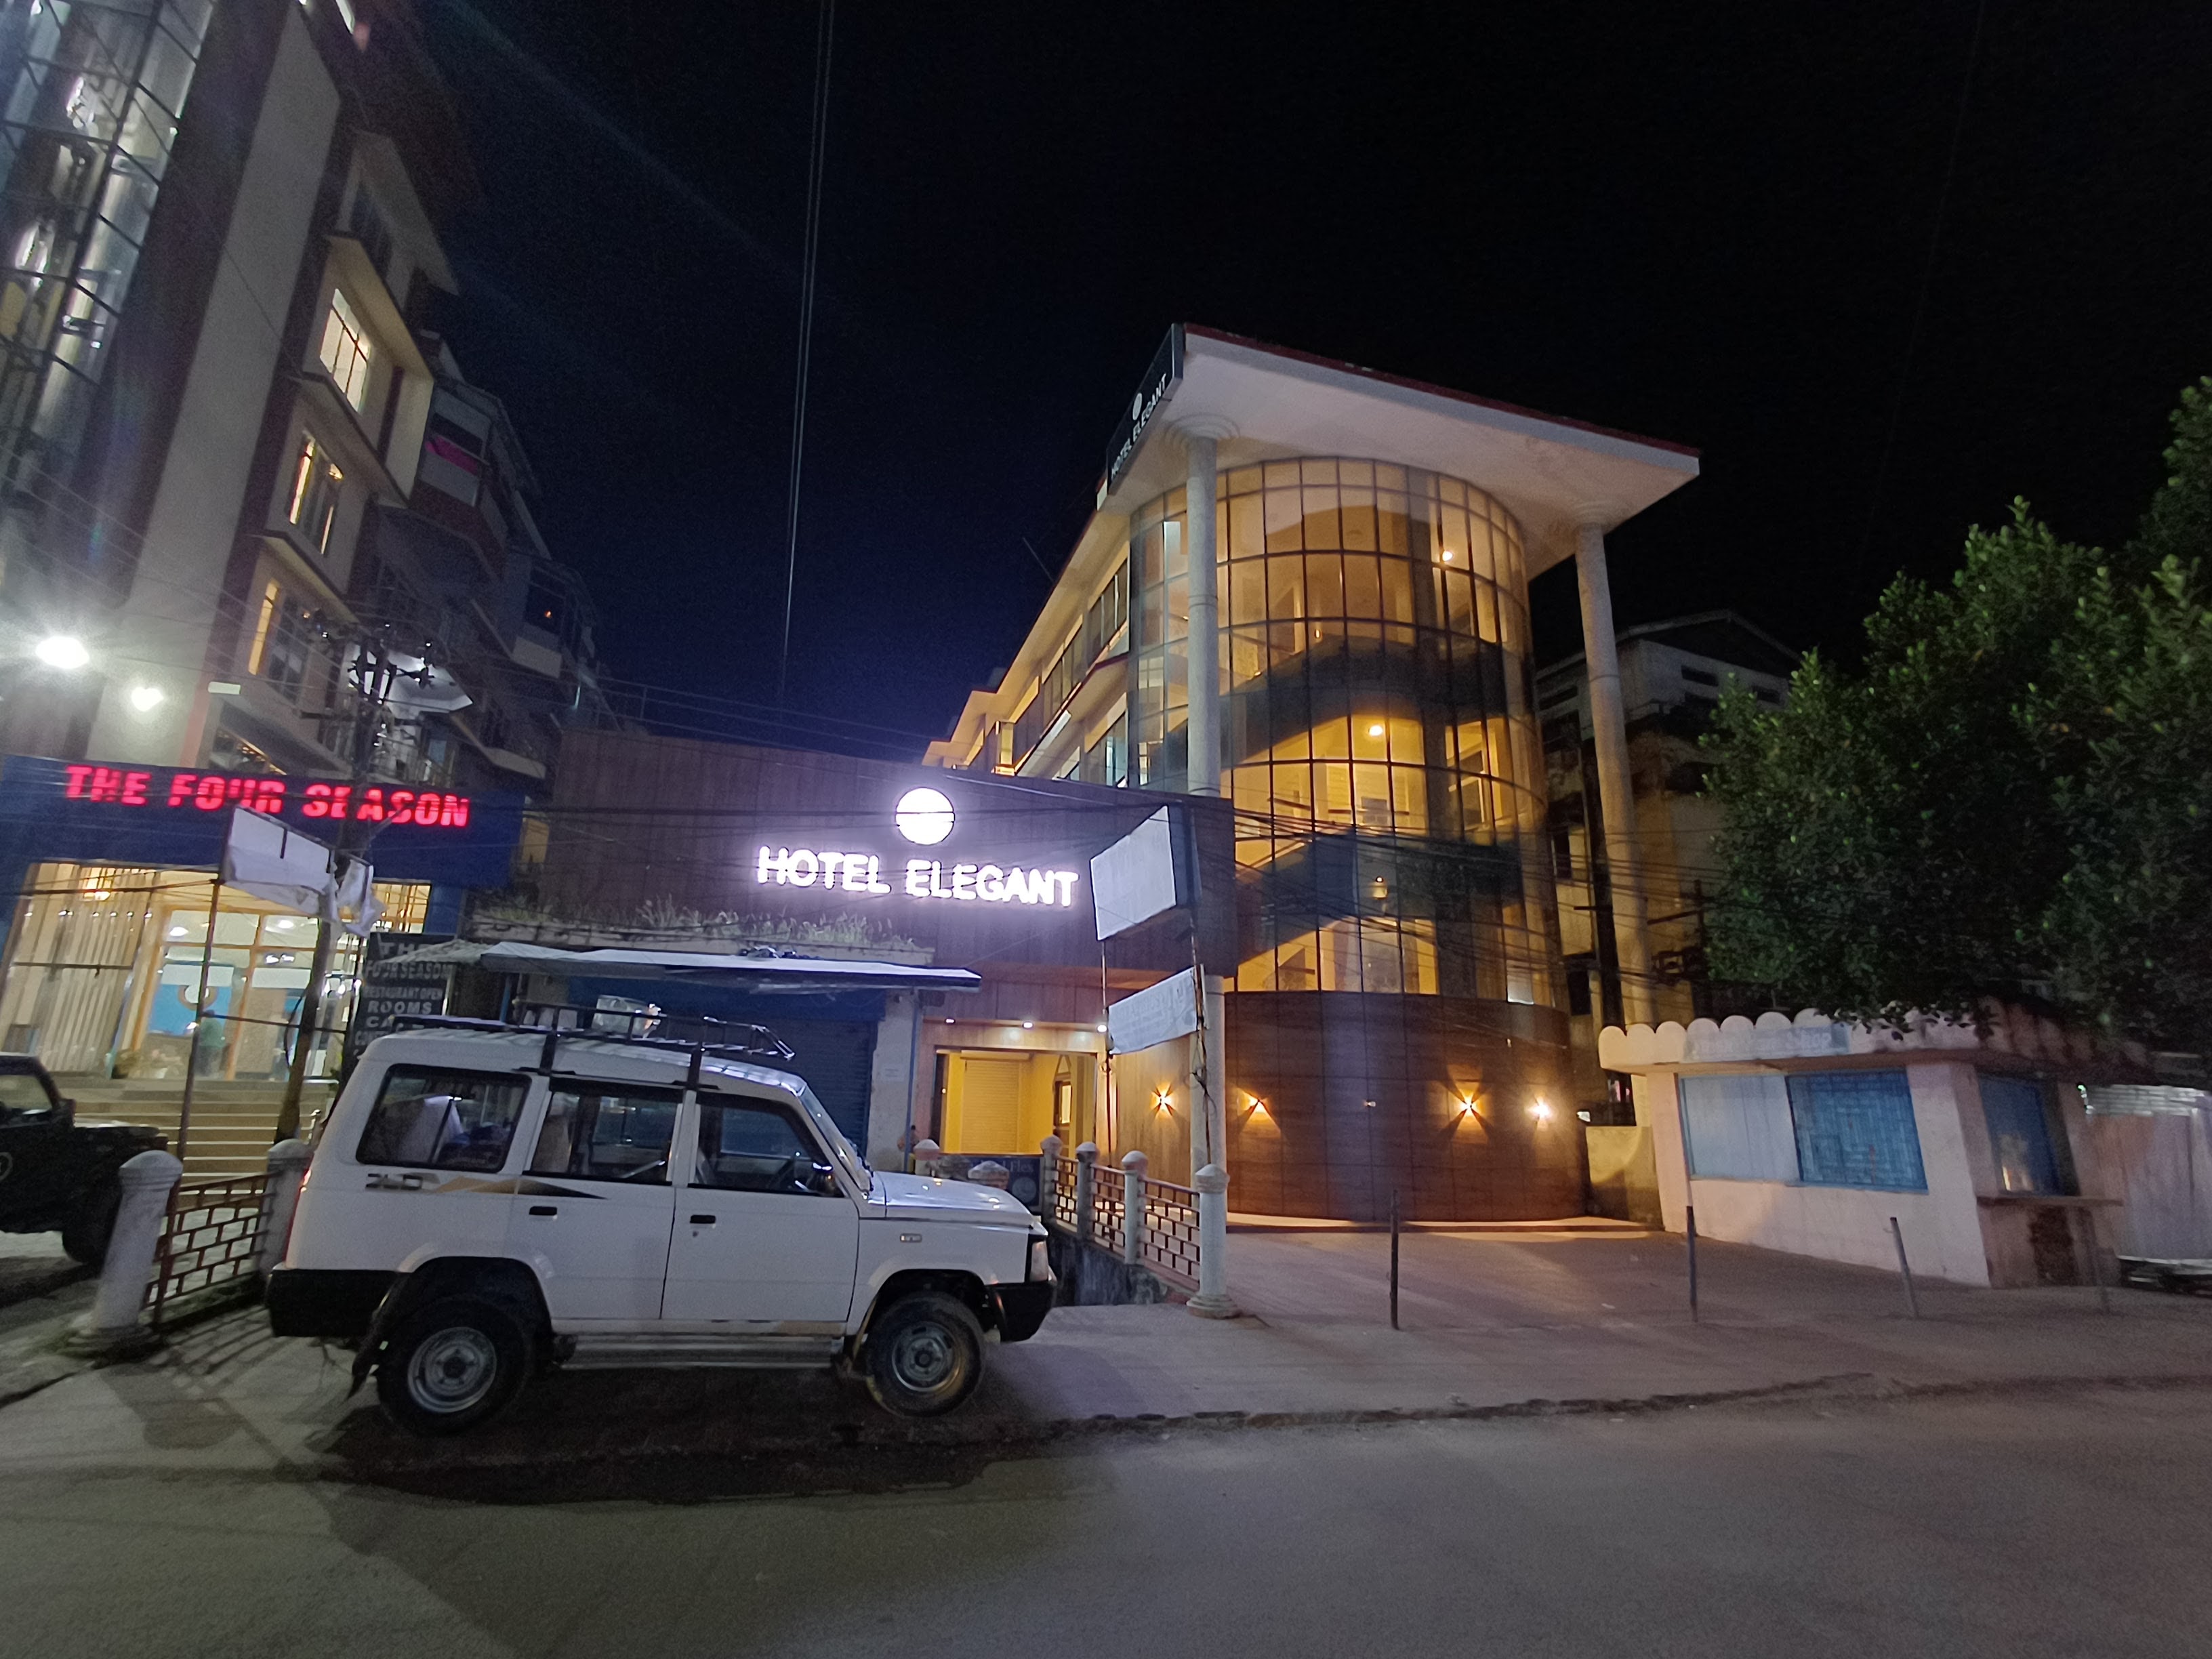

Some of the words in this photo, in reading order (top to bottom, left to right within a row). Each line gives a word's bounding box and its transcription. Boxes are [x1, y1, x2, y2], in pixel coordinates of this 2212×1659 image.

[1111, 437, 1132, 481] HOTEL
[1132, 372, 1166, 443] ELEGANT
[65, 765, 151, 806] THE
[167, 774, 285, 814] FOUR
[302, 784, 470, 827] SEASON
[757, 845, 891, 894] HOTEL
[905, 859, 1080, 907] ELEGANT
[379, 942, 434, 960] TH
[367, 1000, 432, 1015] ROOMS
